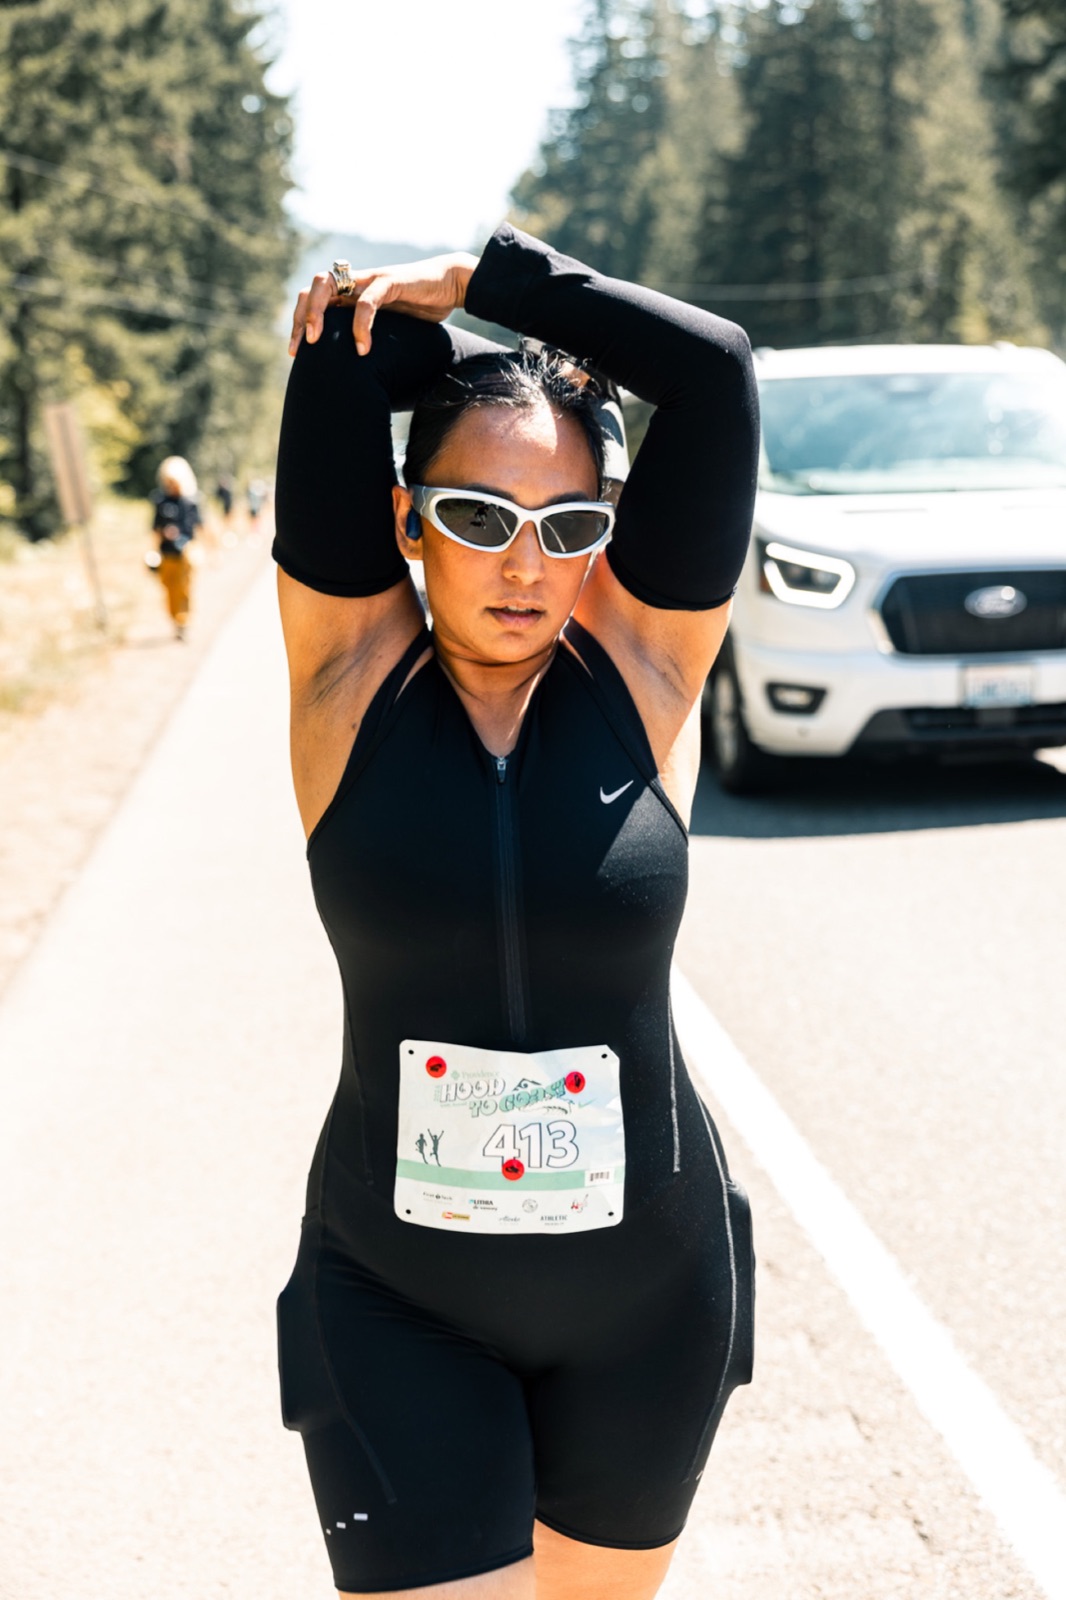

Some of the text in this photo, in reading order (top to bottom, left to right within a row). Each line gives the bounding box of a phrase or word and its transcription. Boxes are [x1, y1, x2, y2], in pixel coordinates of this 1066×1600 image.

[440, 1077, 506, 1103] HOOD
[469, 1077, 567, 1118] TO COAST
[482, 1119, 580, 1169] 413
